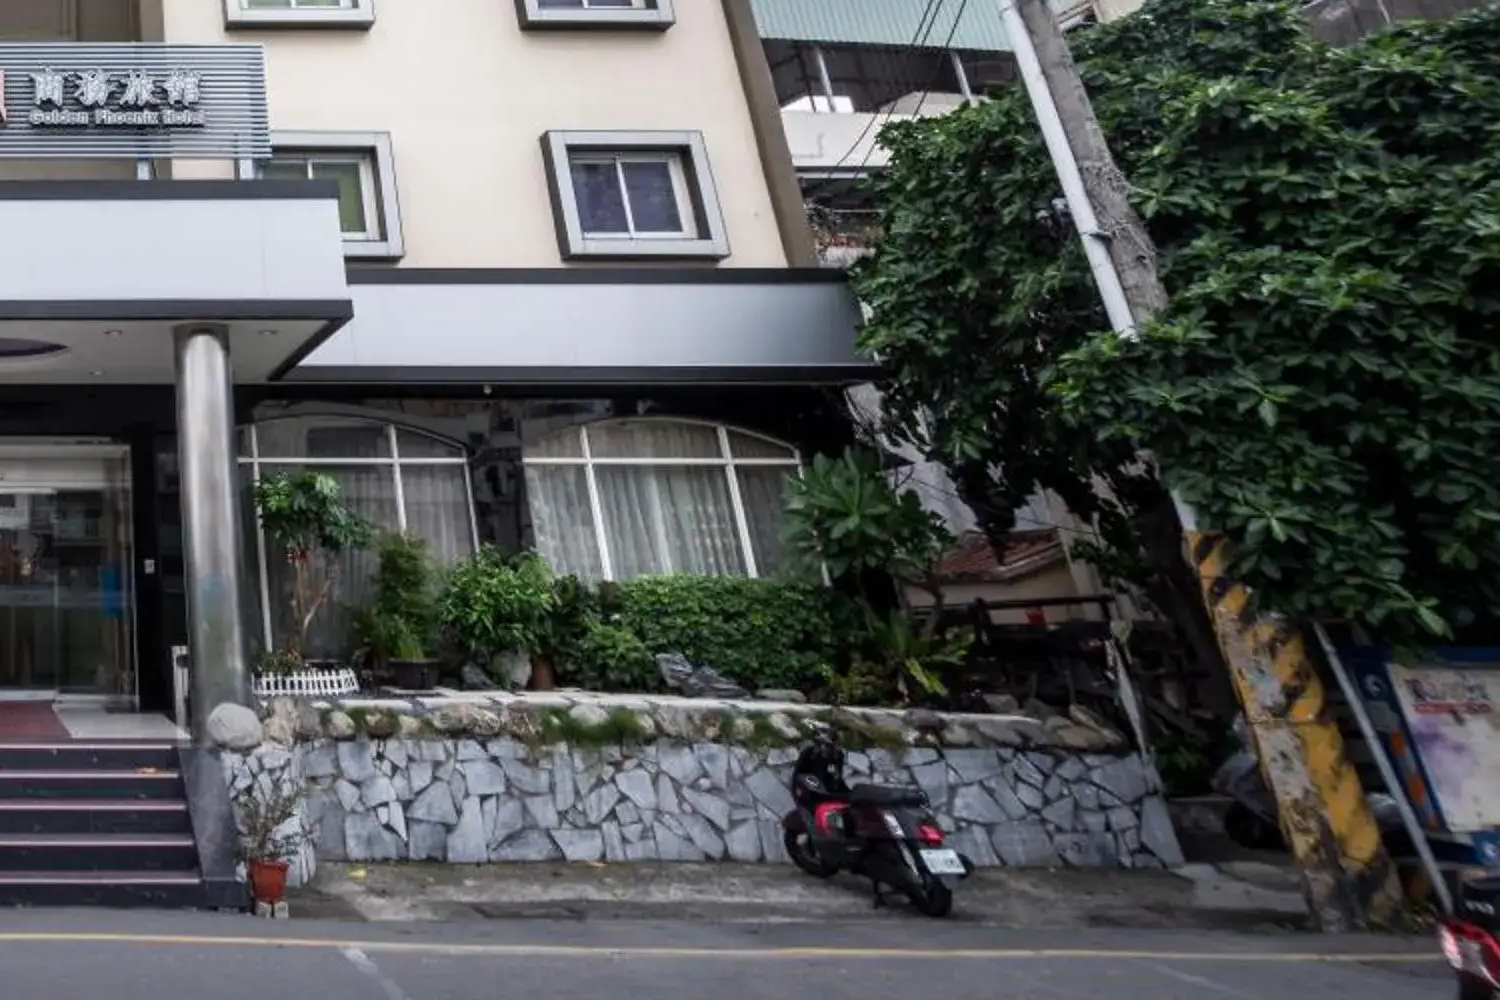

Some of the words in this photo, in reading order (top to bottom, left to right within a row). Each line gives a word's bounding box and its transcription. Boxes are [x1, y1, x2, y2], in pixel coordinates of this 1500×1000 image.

[29, 64, 203, 106] 商務旅館
[29, 109, 89, 125] Golden
[95, 109, 160, 125] Phoenix
[162, 109, 206, 125] Hotel
